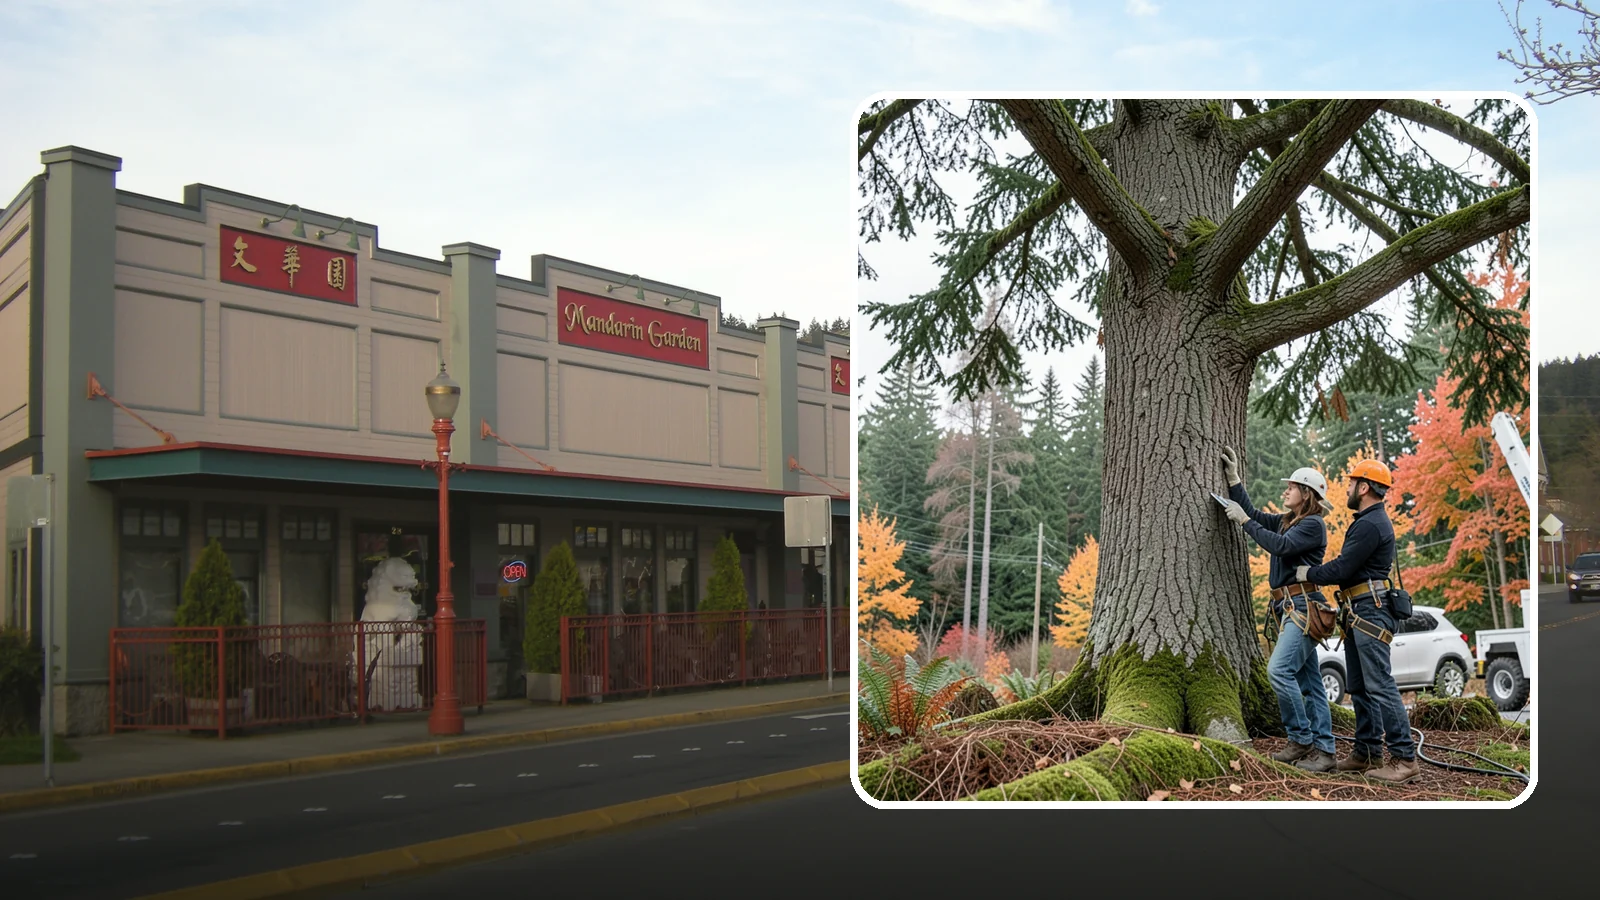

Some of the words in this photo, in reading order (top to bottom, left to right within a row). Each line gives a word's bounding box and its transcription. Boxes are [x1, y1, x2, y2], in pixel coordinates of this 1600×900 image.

[231, 236, 346, 290] 文華園
[564, 302, 644, 341] Mandarin
[648, 320, 702, 352] Garden
[834, 363, 847, 387] 文
[503, 565, 527, 578] OPEN
